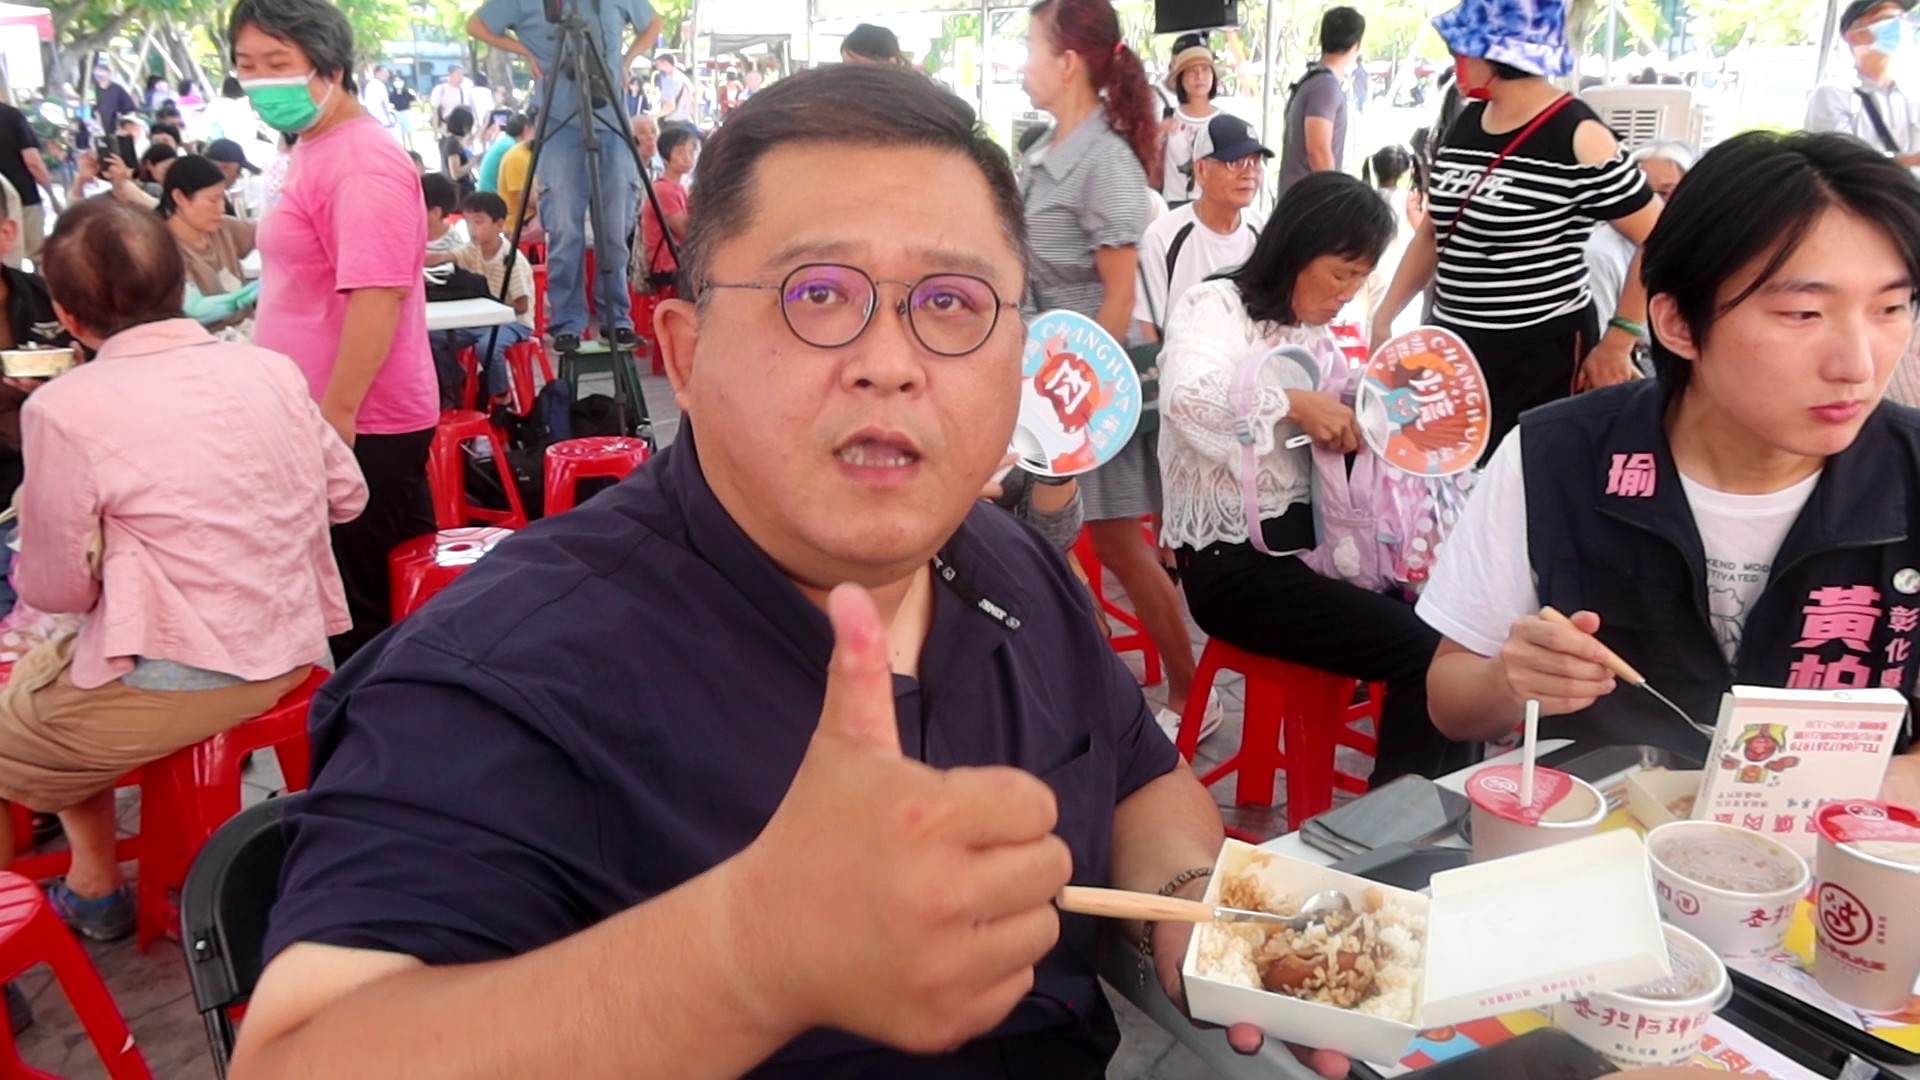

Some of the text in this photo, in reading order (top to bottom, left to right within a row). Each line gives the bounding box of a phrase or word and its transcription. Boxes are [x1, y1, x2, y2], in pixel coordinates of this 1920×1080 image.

[1041, 321, 1131, 413] CHANGHUA
[1044, 359, 1092, 415] 肉
[1430, 336, 1483, 454] CHANGHUA
[1605, 452, 1656, 497] 瑜
